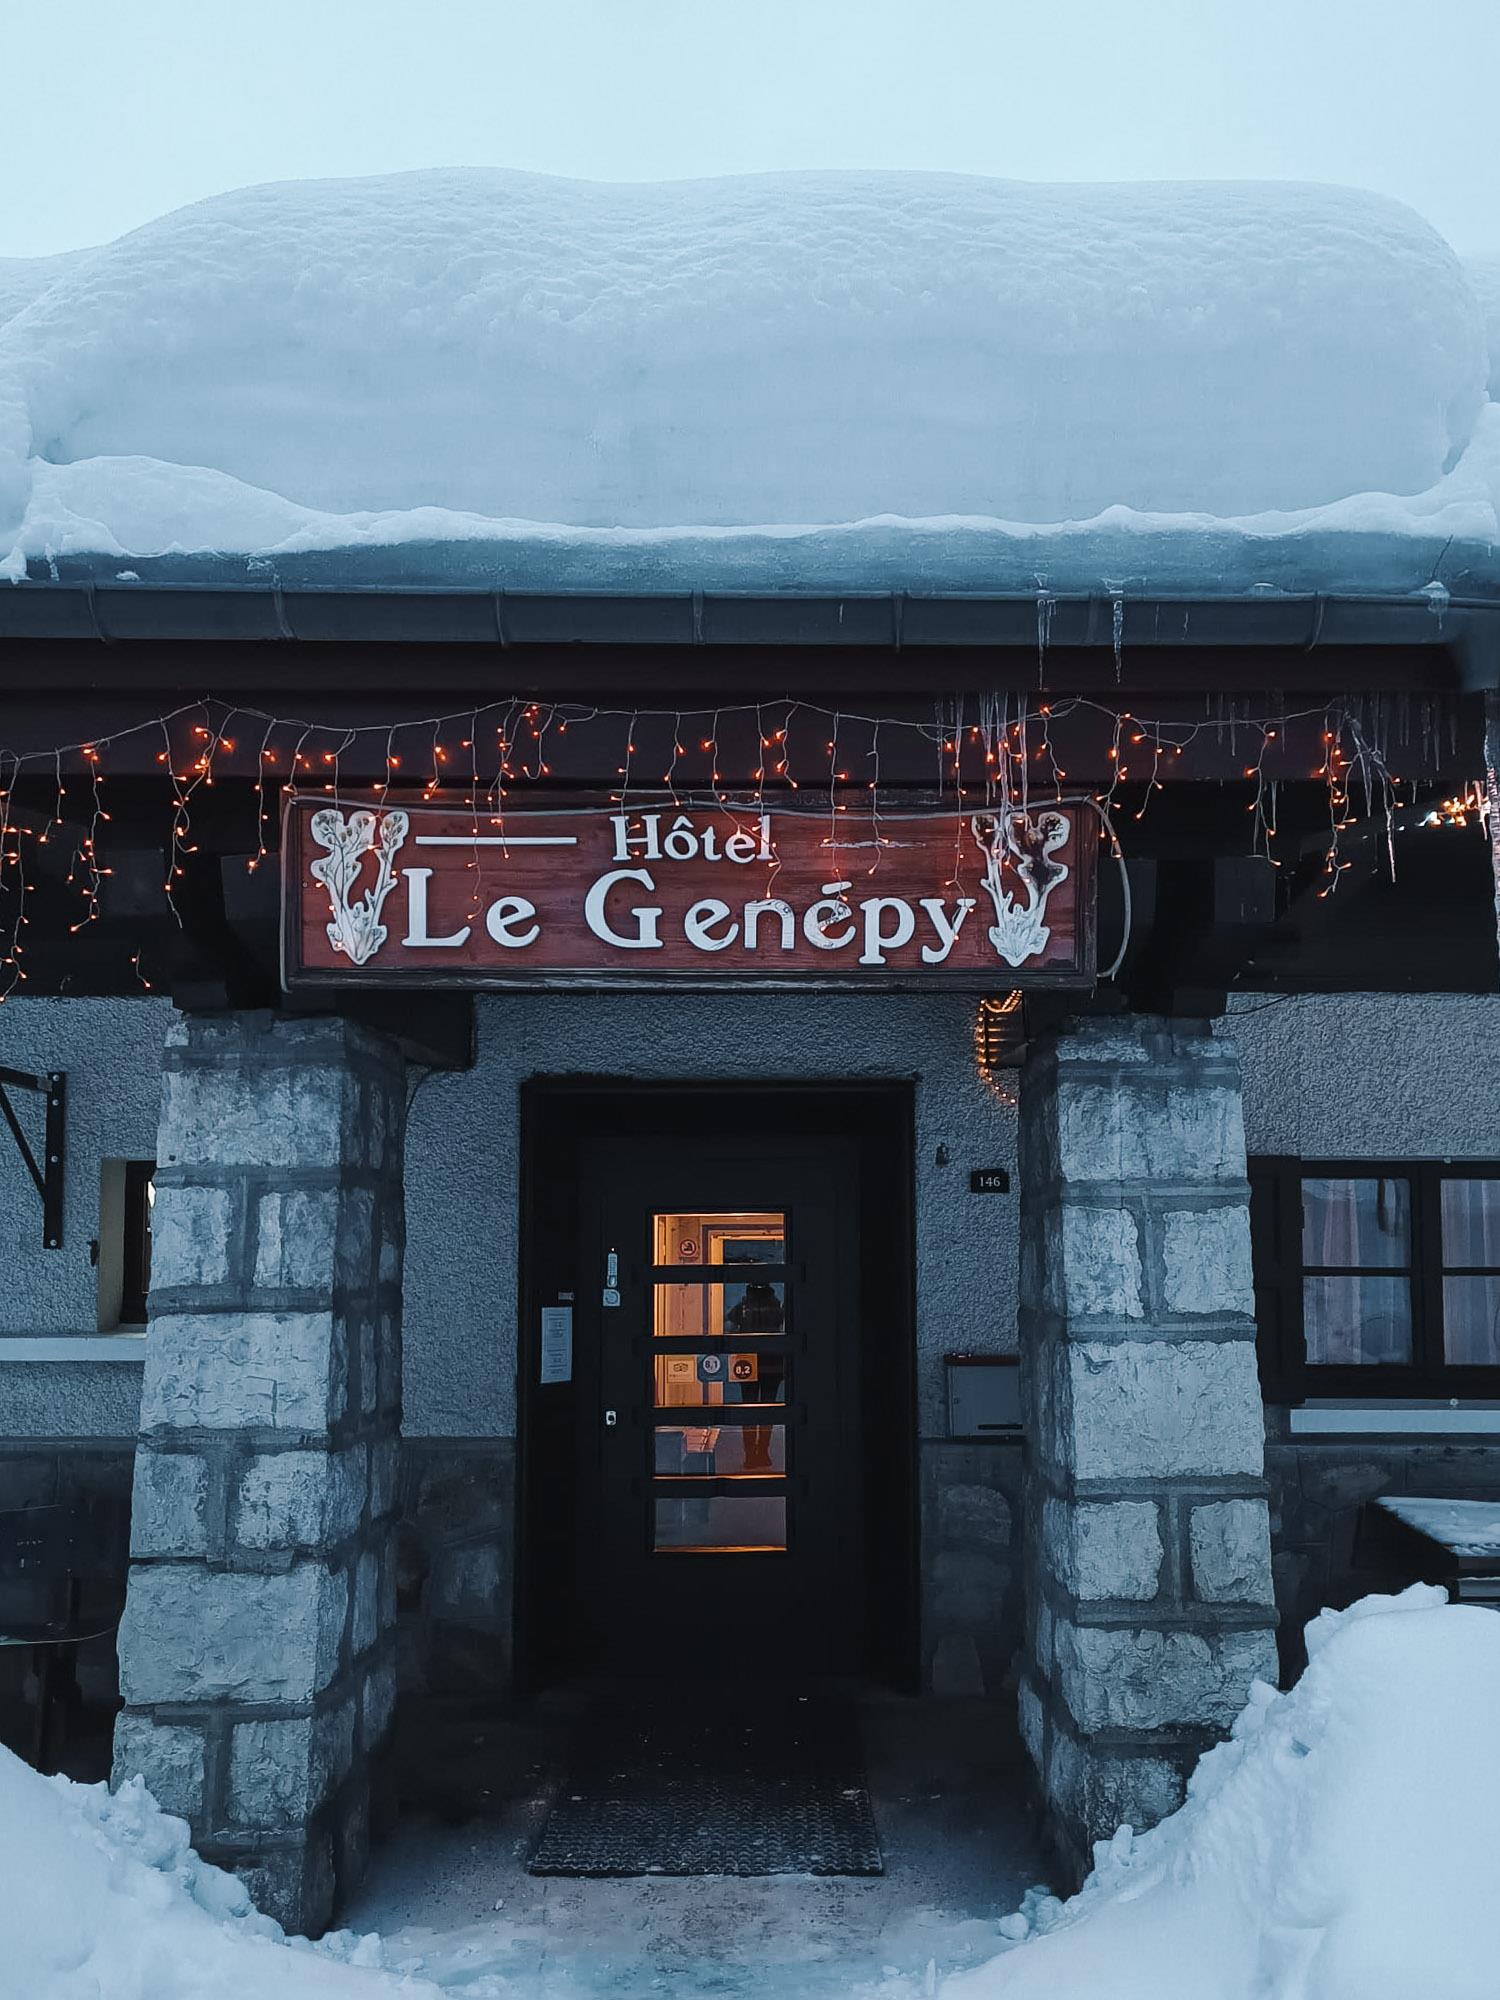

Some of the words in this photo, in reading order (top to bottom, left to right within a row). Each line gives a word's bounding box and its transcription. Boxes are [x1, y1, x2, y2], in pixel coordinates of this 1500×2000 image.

[609, 814, 773, 863] Hôtel
[401, 868, 540, 947] Le
[585, 868, 976, 964] Genépy
[980, 1176, 1001, 1188] 146
